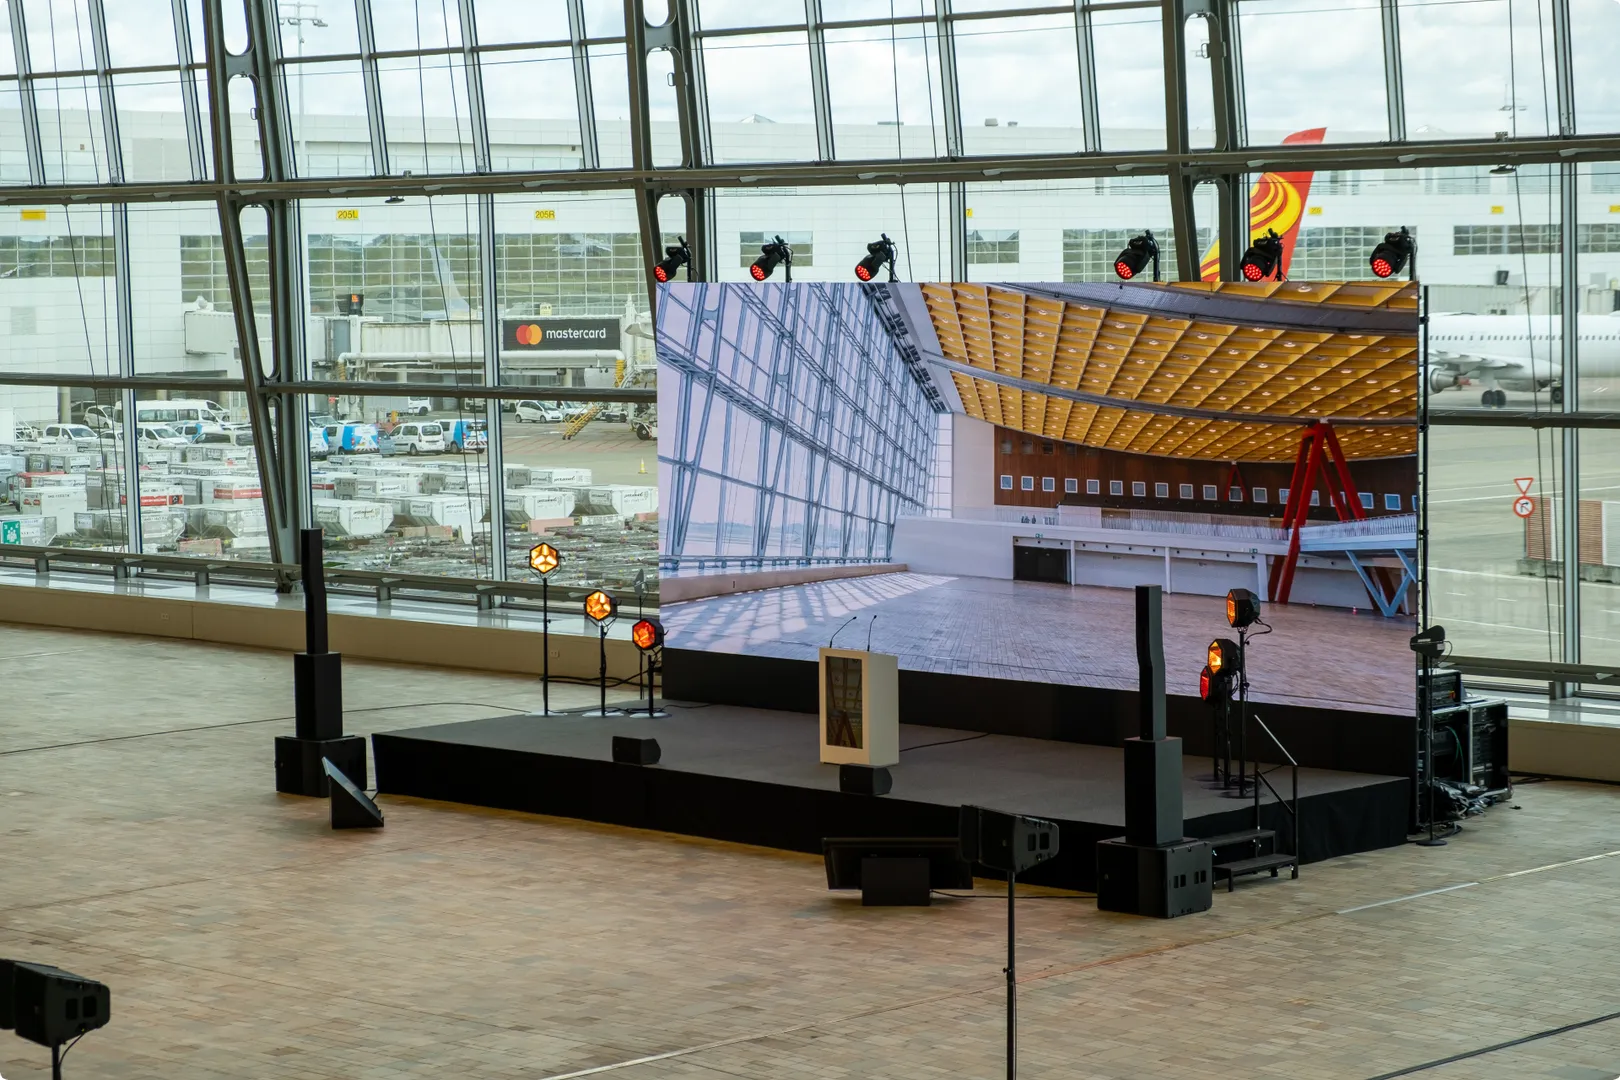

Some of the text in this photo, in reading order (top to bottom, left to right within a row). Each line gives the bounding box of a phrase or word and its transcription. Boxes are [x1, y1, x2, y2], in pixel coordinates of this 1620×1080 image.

[337, 210, 358, 219] 205L
[535, 210, 555, 219] 205R
[546, 327, 606, 339] mastercard
